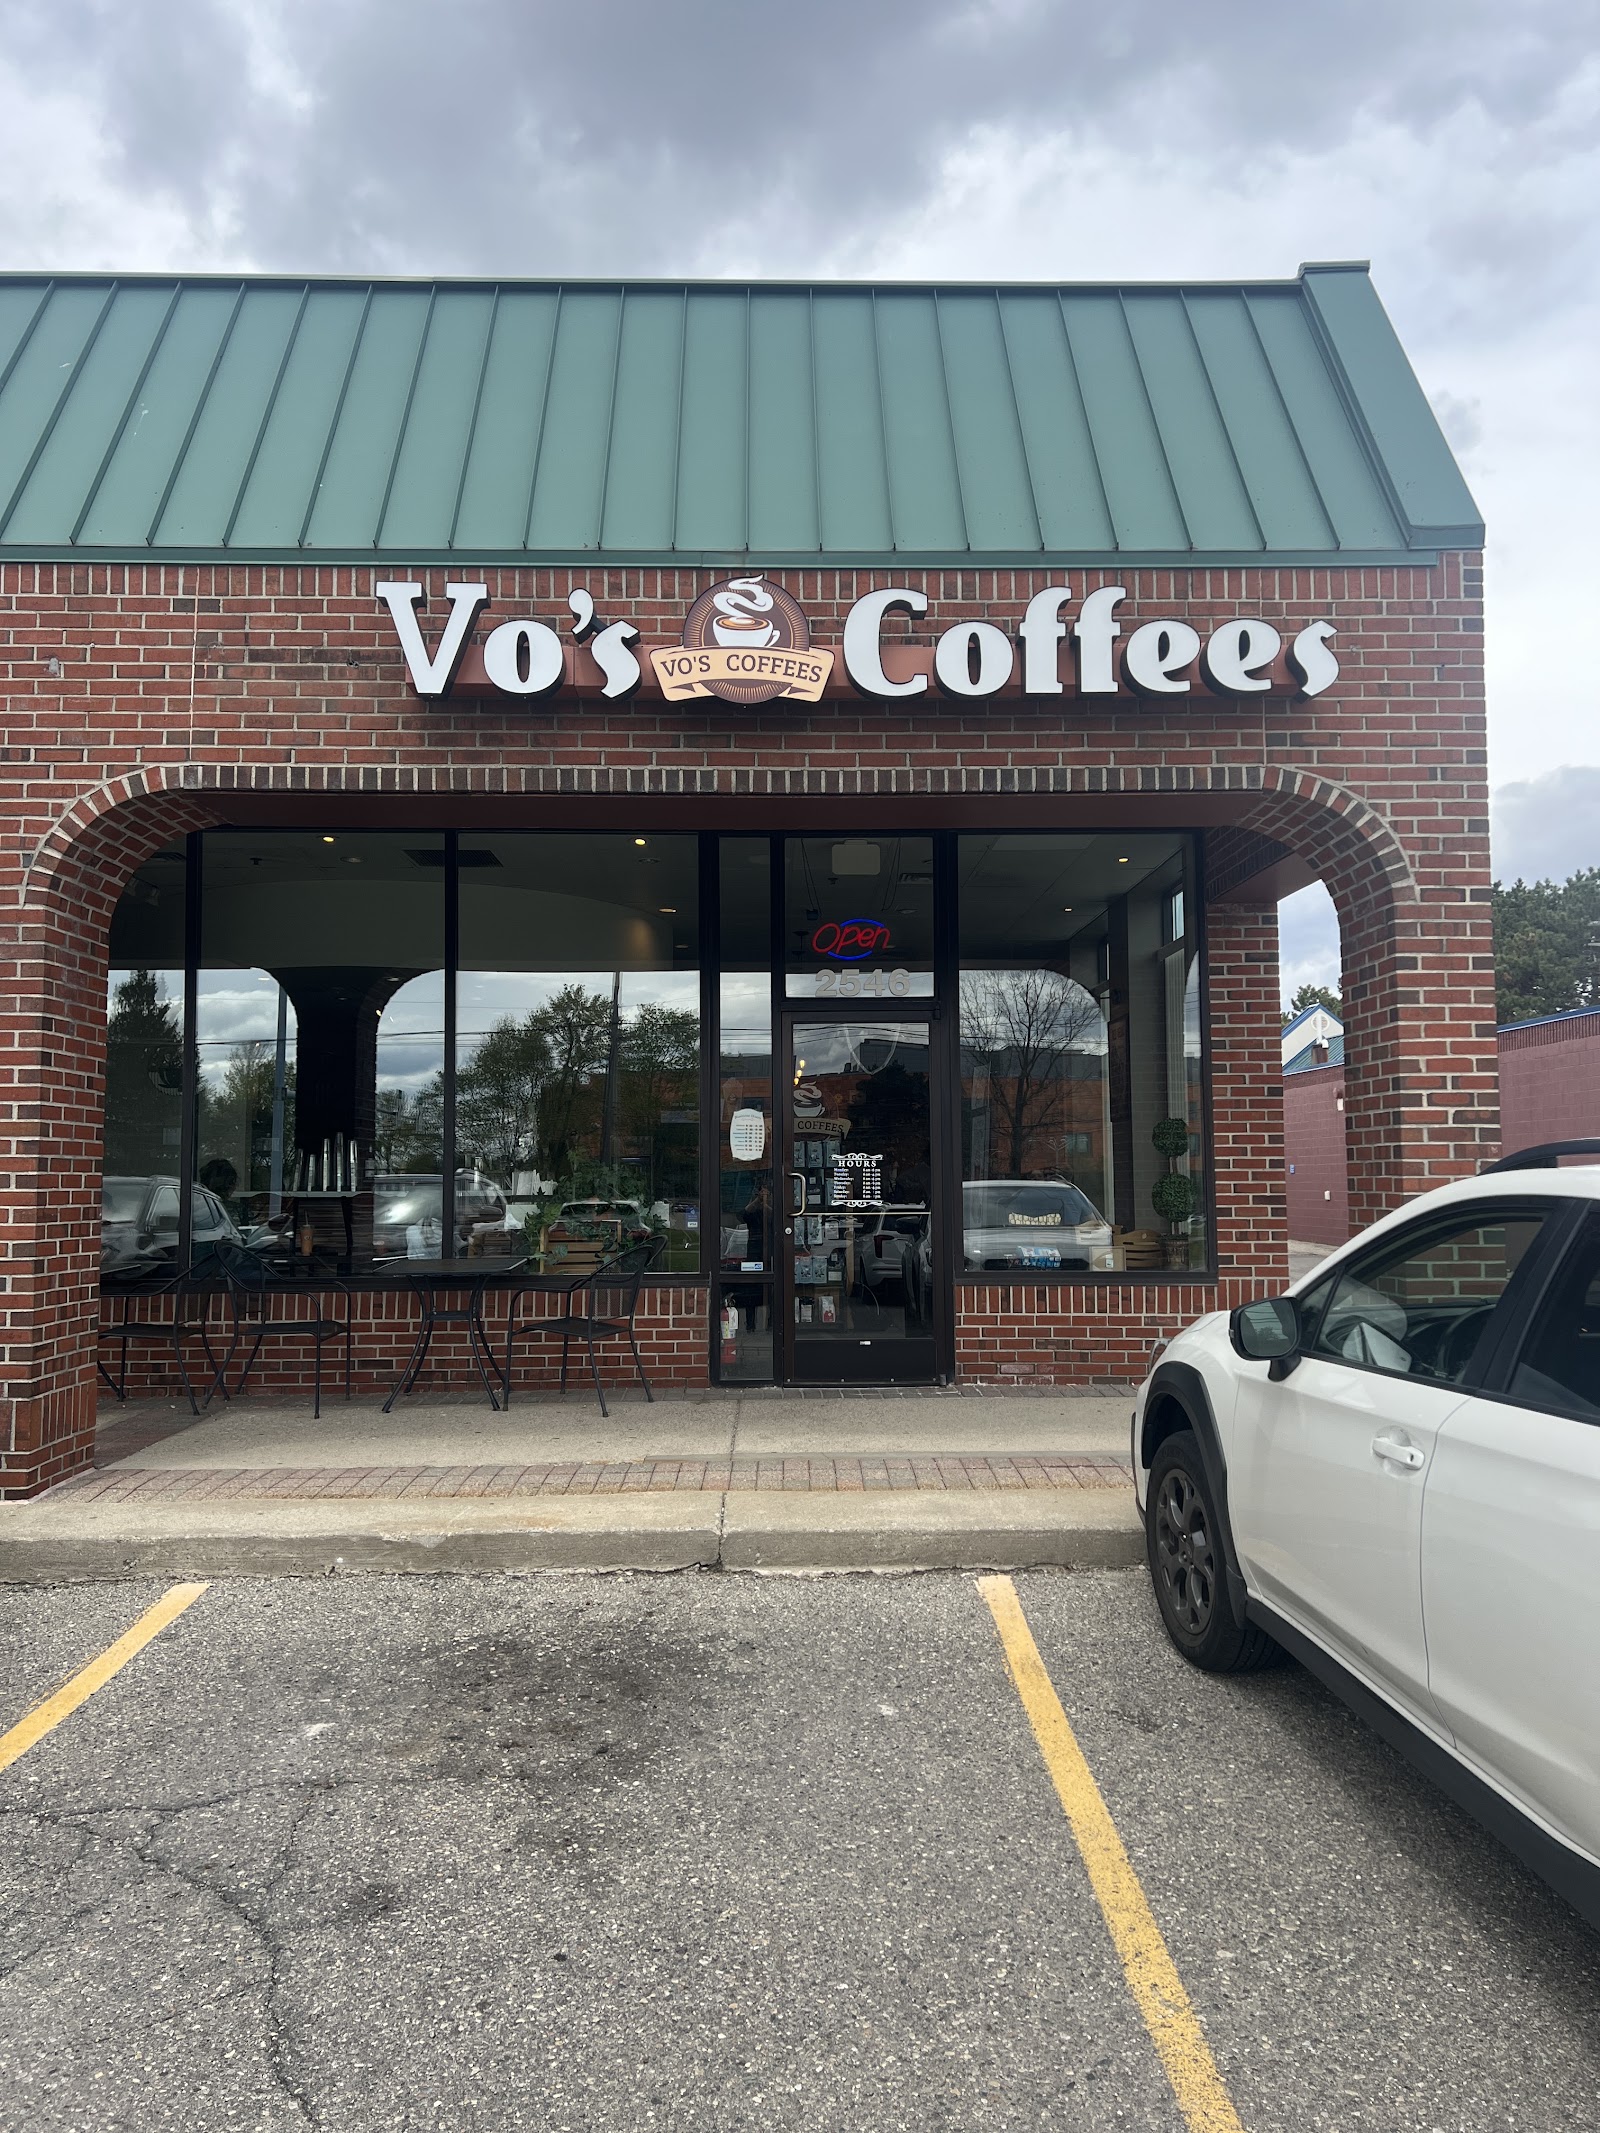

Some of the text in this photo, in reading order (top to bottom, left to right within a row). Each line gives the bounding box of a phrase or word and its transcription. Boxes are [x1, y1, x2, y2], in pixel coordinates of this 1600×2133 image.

[376, 581, 1341, 699] Vo's Coffees
[660, 654, 823, 683] VO'S COFFEES
[812, 922, 891, 954] Open
[815, 968, 910, 997] 2546
[797, 1120, 844, 1134] COFFEES
